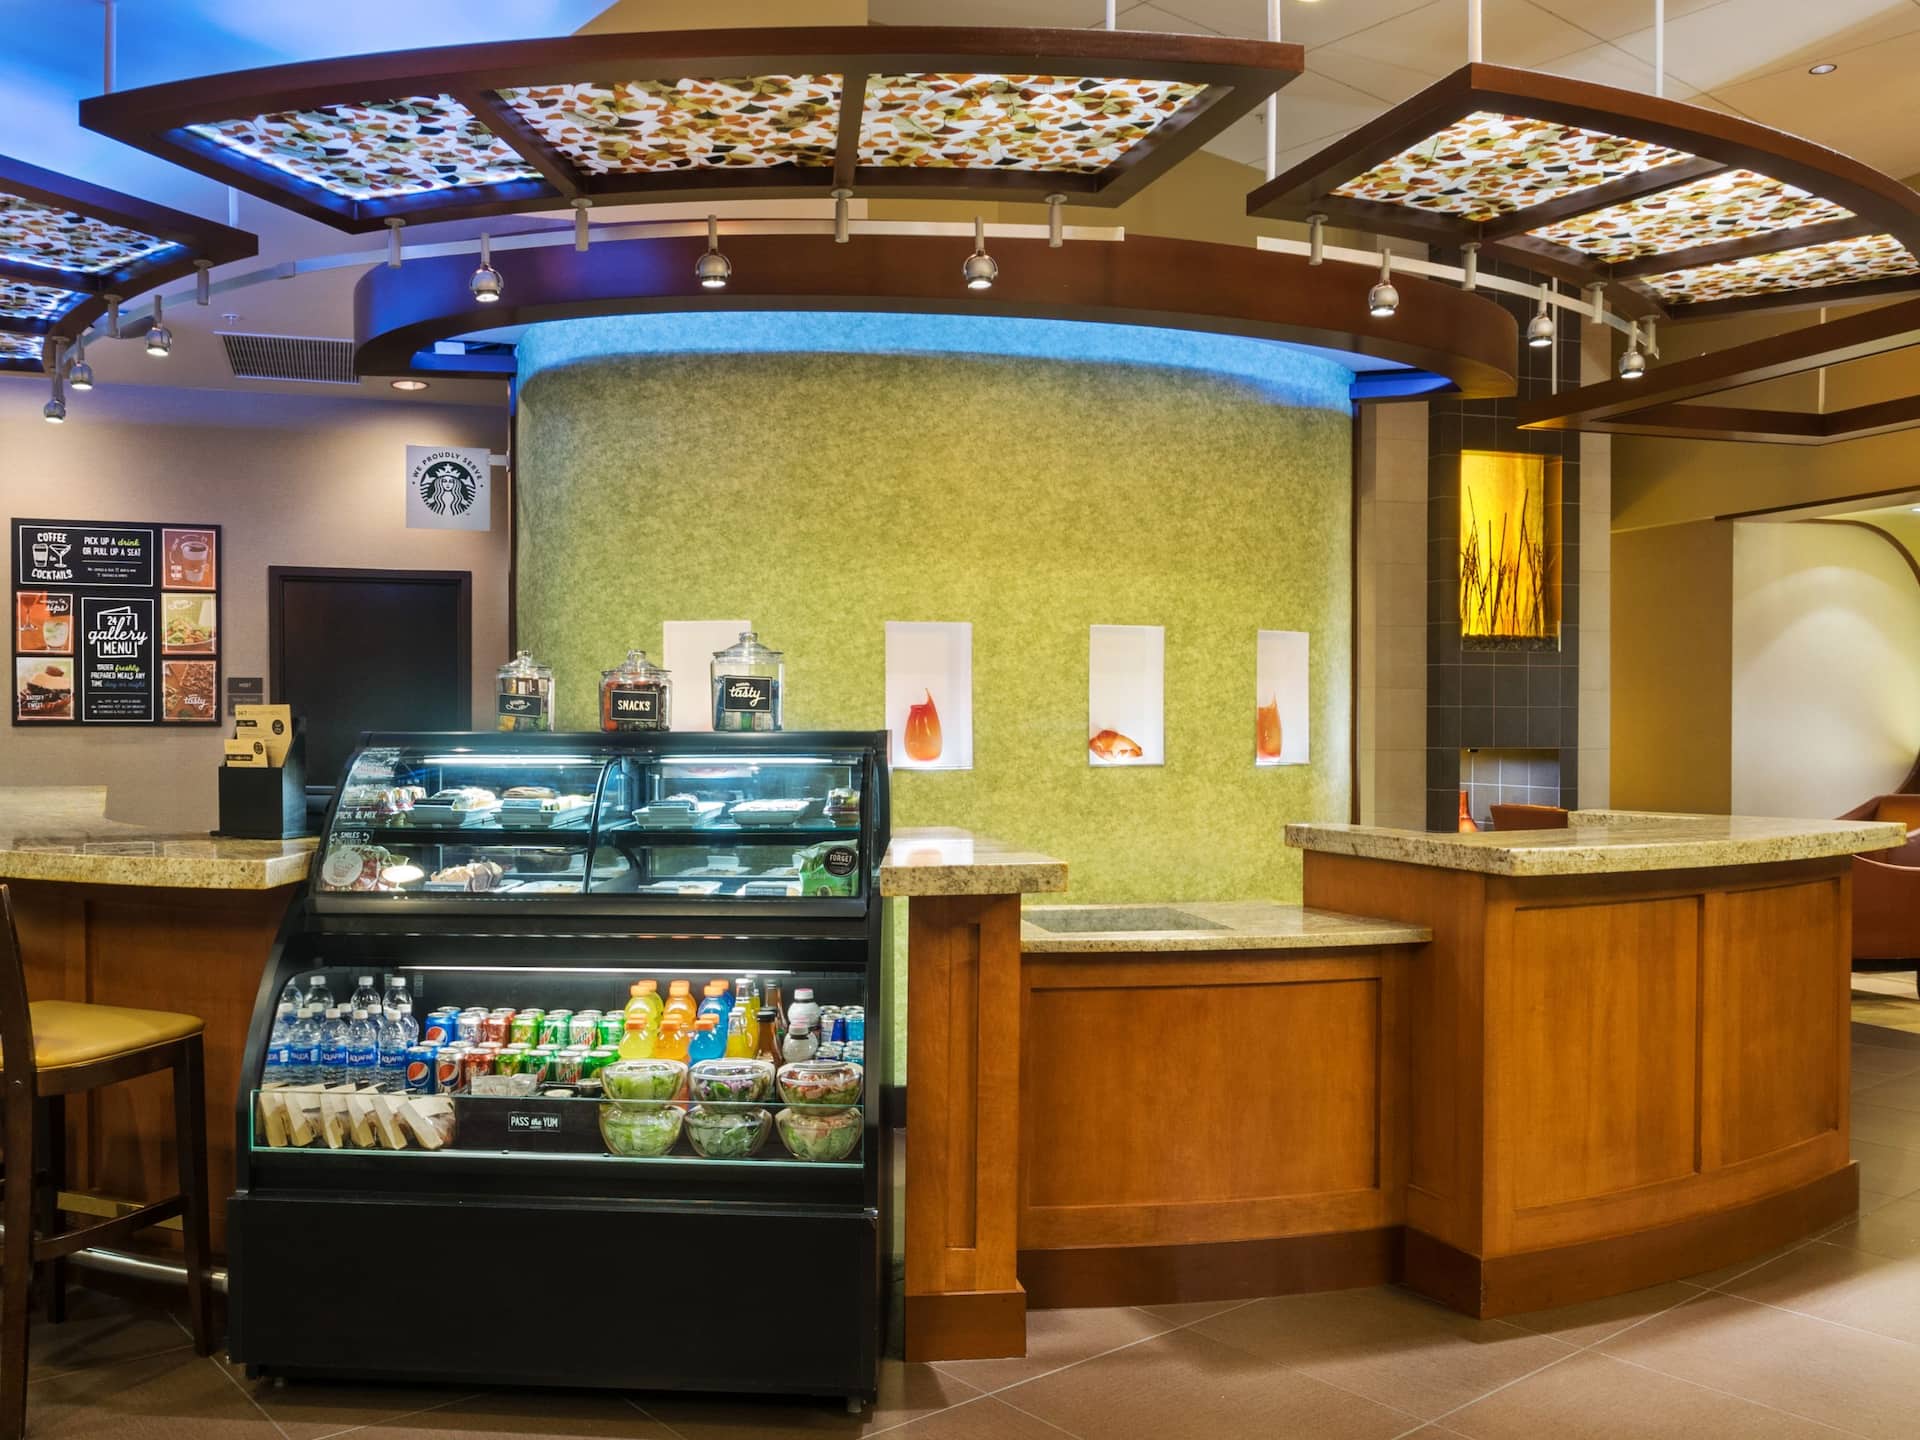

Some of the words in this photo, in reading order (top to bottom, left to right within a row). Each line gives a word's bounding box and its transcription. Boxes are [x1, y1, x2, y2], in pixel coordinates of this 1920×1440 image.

[413, 466, 422, 477] WE
[422, 452, 460, 465] PROUDLY
[463, 457, 482, 480] SERVE
[37, 532, 67, 543] COFFEE
[84, 536, 99, 545] PICK
[100, 536, 110, 545] UP
[111, 537, 116, 546] A
[117, 538, 141, 547] drink
[82, 546, 92, 555] OR
[93, 546, 108, 556] PULL
[109, 547, 119, 556] UP
[120, 547, 125, 556] A
[127, 547, 141, 557] SEAT
[31, 568, 73, 580] COCKTAILS
[88, 616, 148, 646] gallery
[103, 641, 132, 655] MENU
[90, 671, 116, 680] PREPARED
[117, 671, 134, 681] MEALS
[729, 685, 766, 707] tasty
[617, 699, 651, 711] SNACKS
[363, 811, 378, 820] MIX
[830, 854, 852, 862] FORGET
[511, 1116, 530, 1127] PASS
[530, 1118, 542, 1126] the
[543, 1117, 558, 1128] YUM
